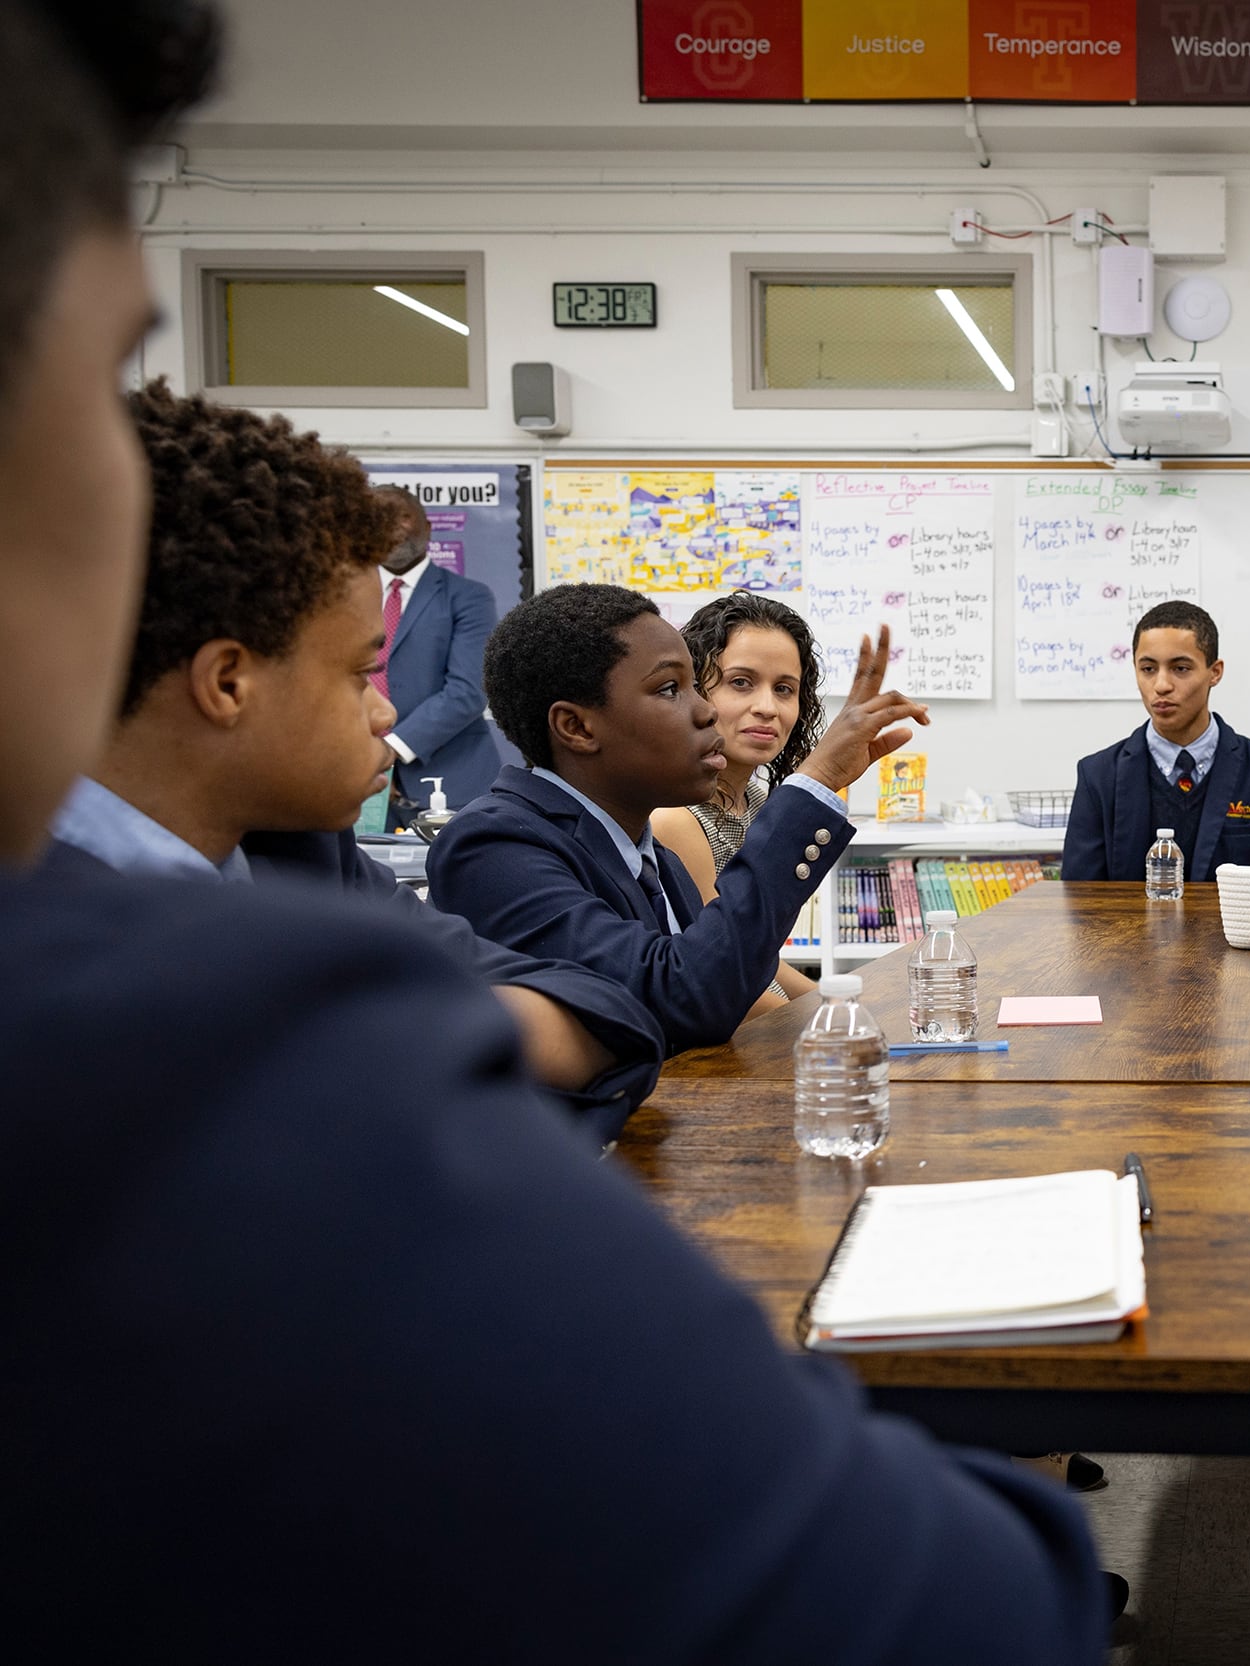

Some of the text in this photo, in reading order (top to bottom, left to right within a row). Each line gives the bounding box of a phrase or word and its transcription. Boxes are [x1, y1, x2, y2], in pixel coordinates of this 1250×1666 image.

[675, 33, 771, 60] Courage
[847, 35, 925, 54] Justice
[984, 33, 1121, 57] Temperance
[567, 288, 626, 320] 12:38
[815, 473, 885, 495] Reflective
[900, 475, 937, 496] Project
[1026, 477, 1103, 495] Extended
[1112, 477, 1148, 496] Essay
[448, 483, 496, 505] you?
[888, 494, 917, 511] CP
[1099, 495, 1124, 512] DP
[811, 521, 880, 542] 4 pages by
[1019, 516, 1094, 537] 4 pages by
[1105, 525, 1124, 541] or
[1132, 521, 1170, 538] Library
[888, 534, 909, 548] or
[911, 527, 990, 545] Library hours
[1023, 531, 1069, 550] March
[810, 541, 850, 557] March
[934, 549, 947, 557] on
[1151, 544, 1165, 552] on
[818, 588, 845, 603] pages
[851, 585, 868, 598] by
[1030, 581, 1061, 597] pages
[1066, 577, 1081, 592] by
[1102, 586, 1123, 599] or
[1129, 585, 1168, 601] Library
[884, 593, 905, 605] or
[908, 590, 987, 607] Library hours
[1022, 594, 1052, 612] April
[810, 602, 843, 618] April
[933, 613, 948, 621] on
[1033, 642, 1064, 659] pages
[1069, 637, 1084, 657] by
[1110, 648, 1131, 660] or
[908, 651, 985, 668] Library hours
[1047, 665, 1059, 673] on
[1062, 658, 1086, 677] May
[931, 667, 946, 676] on
[932, 680, 952, 691] and
